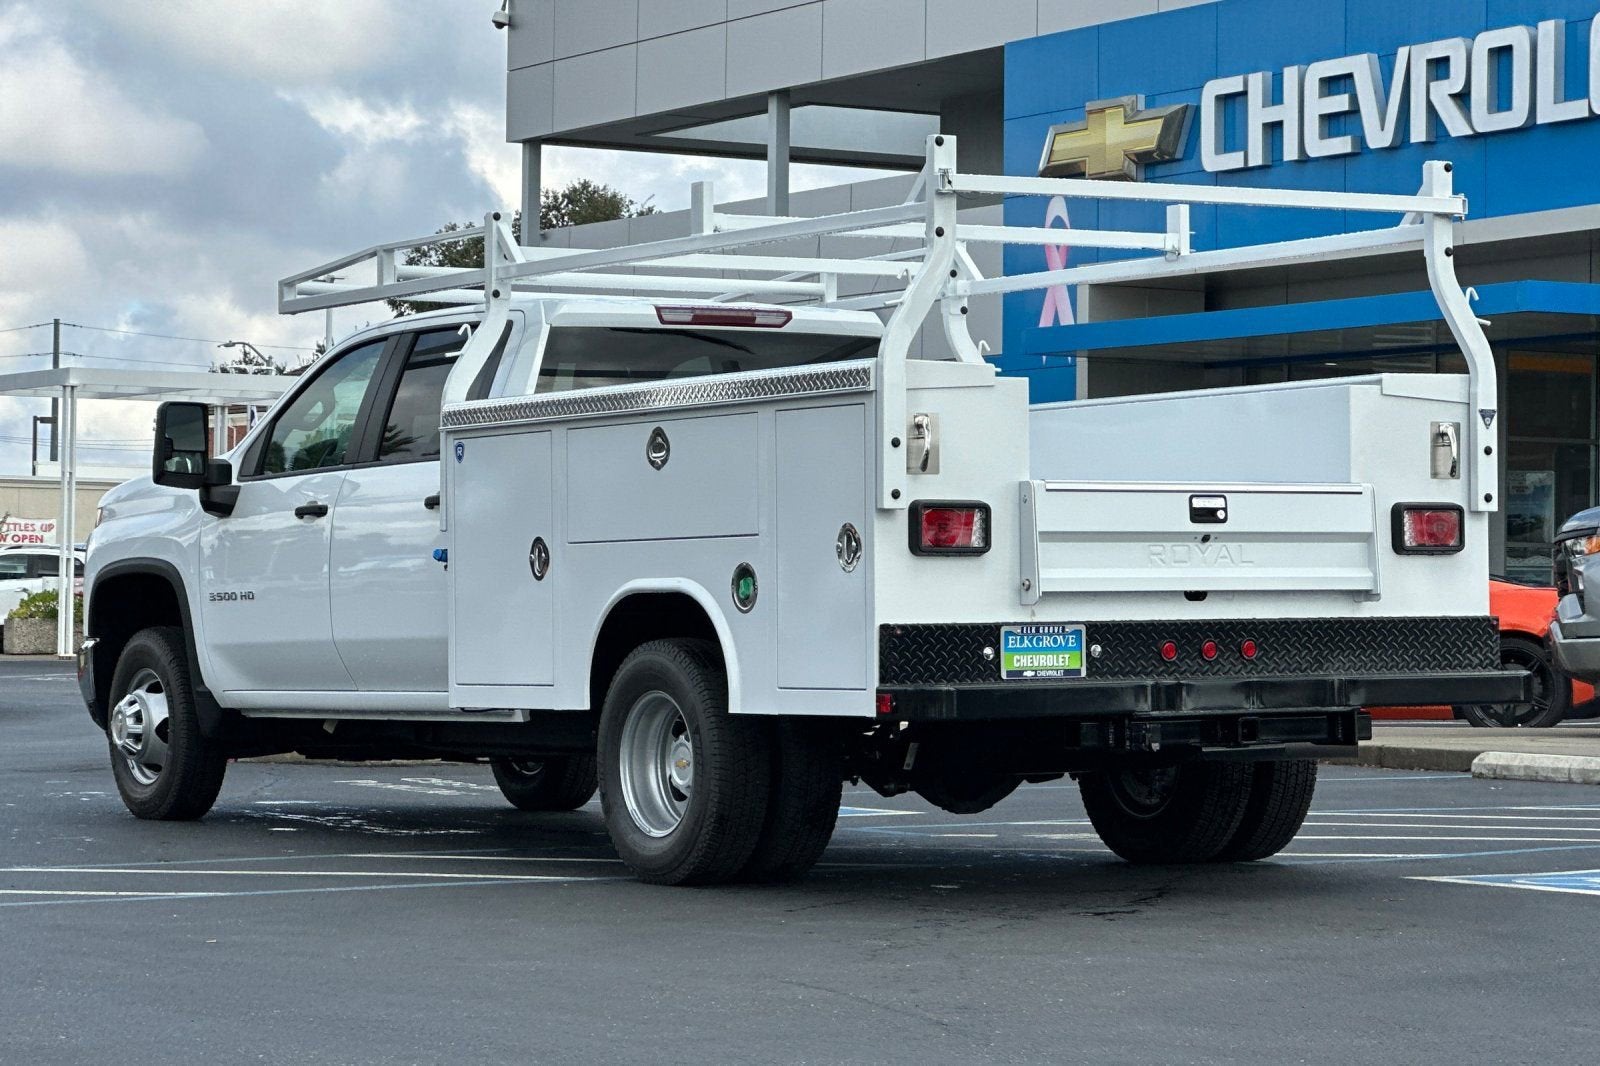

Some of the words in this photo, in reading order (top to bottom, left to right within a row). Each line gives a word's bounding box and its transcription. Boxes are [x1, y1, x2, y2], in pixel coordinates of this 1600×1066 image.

[0, 523, 36, 532] TTLES
[41, 523, 55, 532] UP
[11, 534, 44, 543] OPEN
[1148, 544, 1254, 566] ROYAL
[209, 592, 237, 601] 3500
[240, 591, 255, 600] HD
[1023, 626, 1036, 634] ELK
[1013, 654, 1070, 667] CHEVROLET
